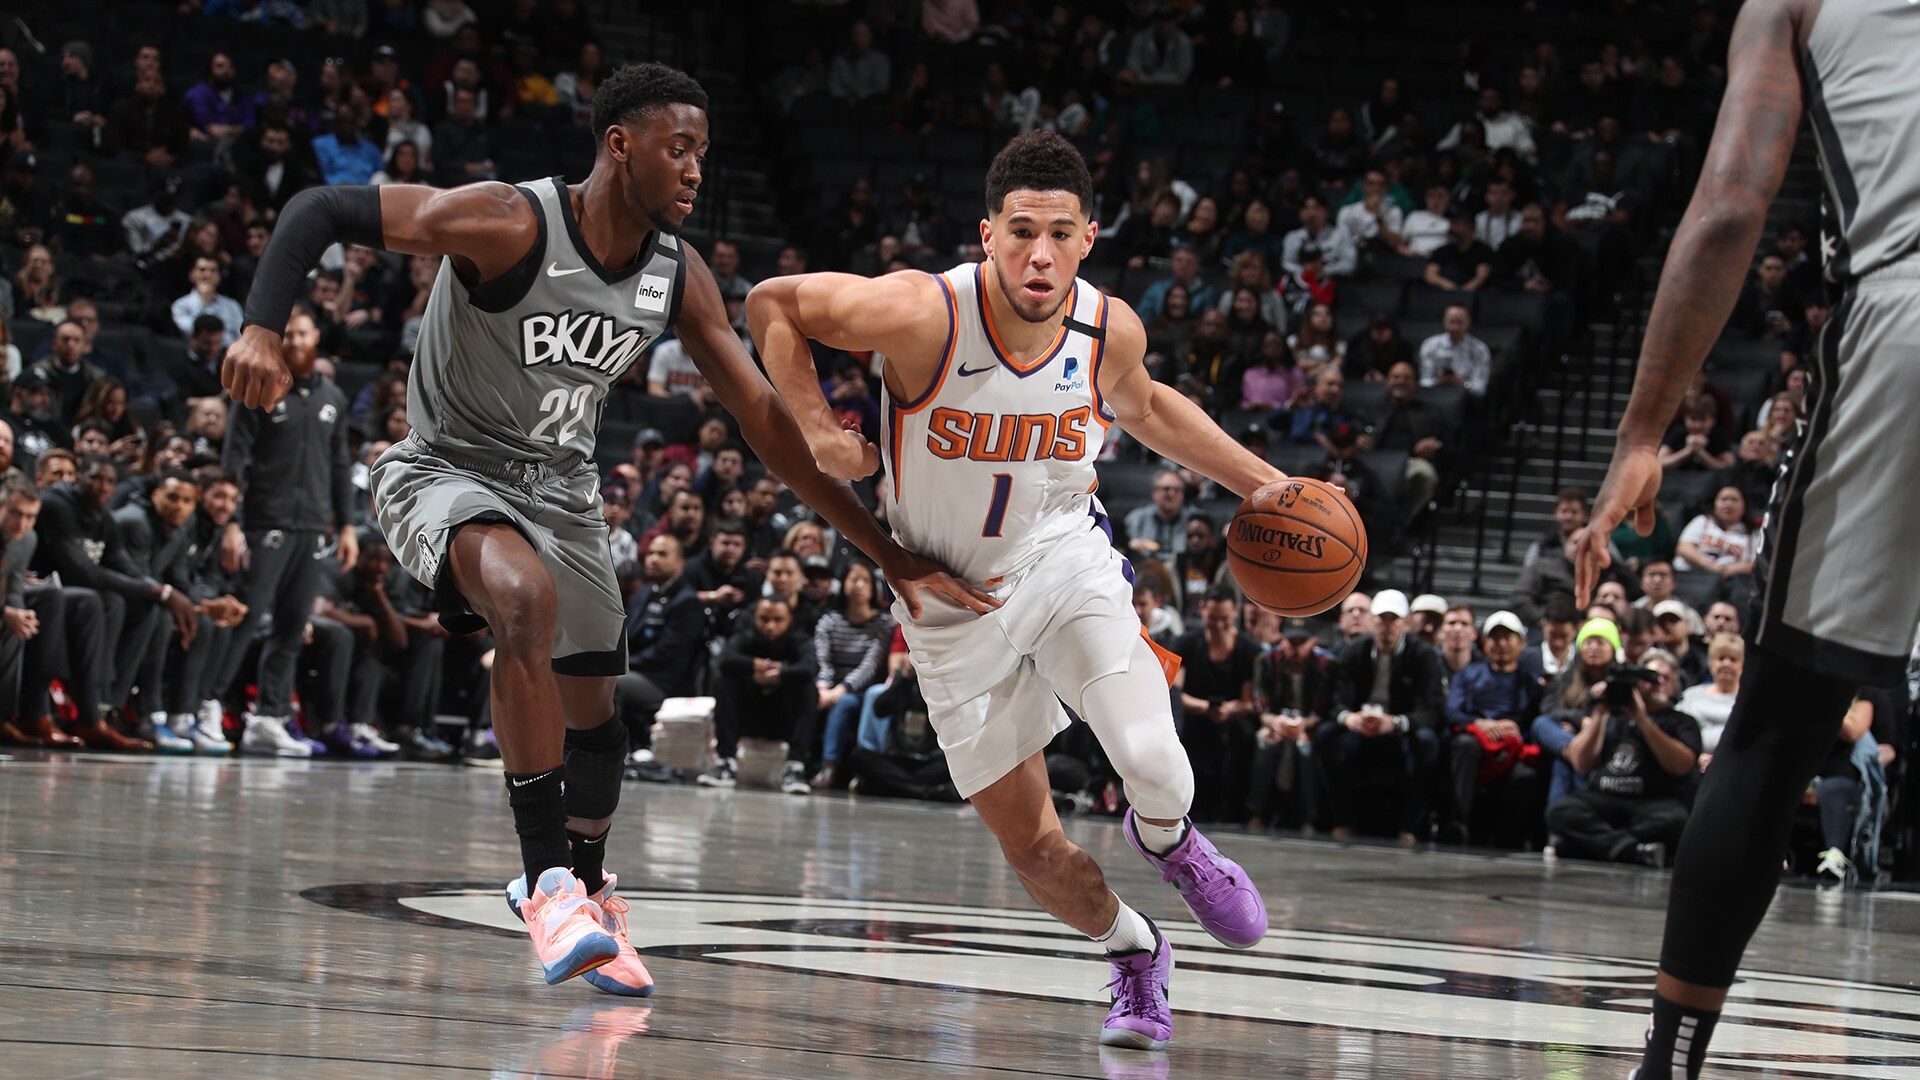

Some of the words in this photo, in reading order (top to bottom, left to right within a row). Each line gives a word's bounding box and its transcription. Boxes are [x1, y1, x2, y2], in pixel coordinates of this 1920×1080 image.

[638, 285, 664, 300] infor
[520, 309, 651, 376] BKLYN
[1054, 380, 1084, 392] PayPal
[529, 384, 593, 446] 22
[981, 473, 1013, 538] 1
[1235, 519, 1327, 559] SPALDING
